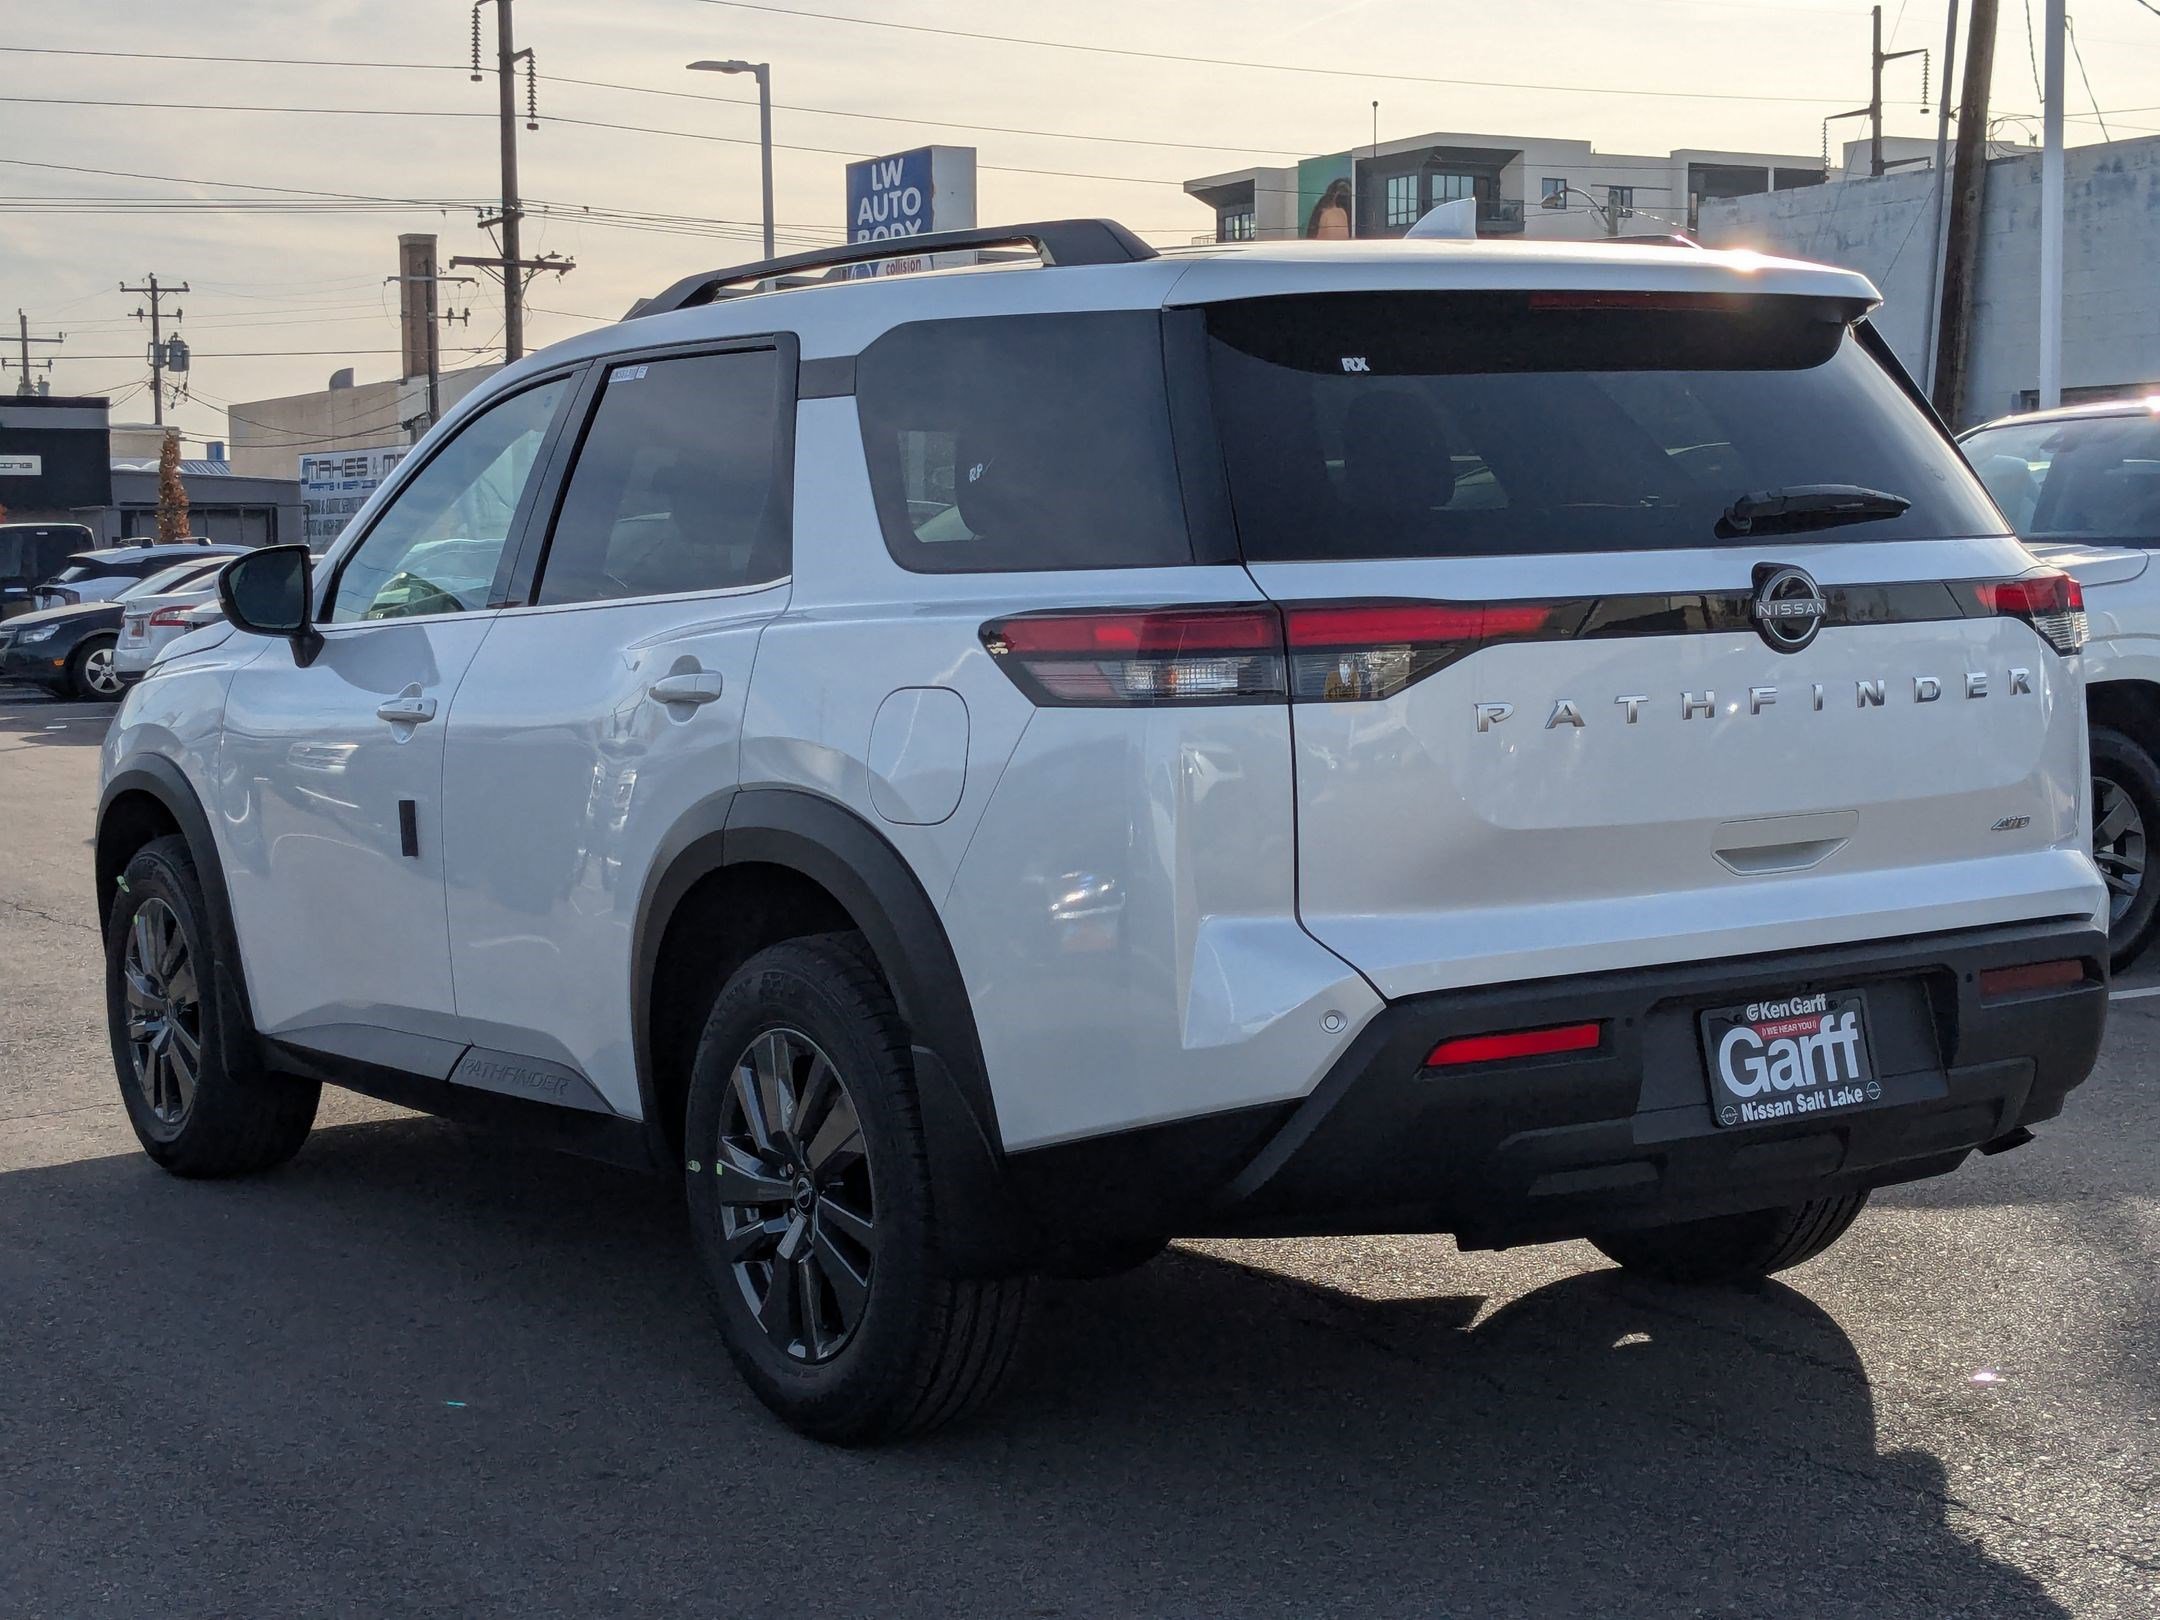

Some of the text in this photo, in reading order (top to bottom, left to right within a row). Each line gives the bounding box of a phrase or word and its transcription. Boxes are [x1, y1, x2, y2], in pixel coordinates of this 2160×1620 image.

[871, 157, 904, 191] LW
[857, 186, 921, 226] AUTO
[885, 258, 921, 276] collision
[1341, 357, 1371, 371] RX
[1759, 602, 1826, 617] NISSAN
[1475, 667, 2032, 732] PATHFINDER
[1789, 993, 1827, 1016] Garff
[1779, 1024, 1798, 1033] HEAR
[1798, 1021, 1813, 1031] YOU
[1718, 1011, 1860, 1098] Garff
[460, 1058, 571, 1095] PATHFINDER
[1740, 1086, 1864, 1123] Nissan Salt Lake
